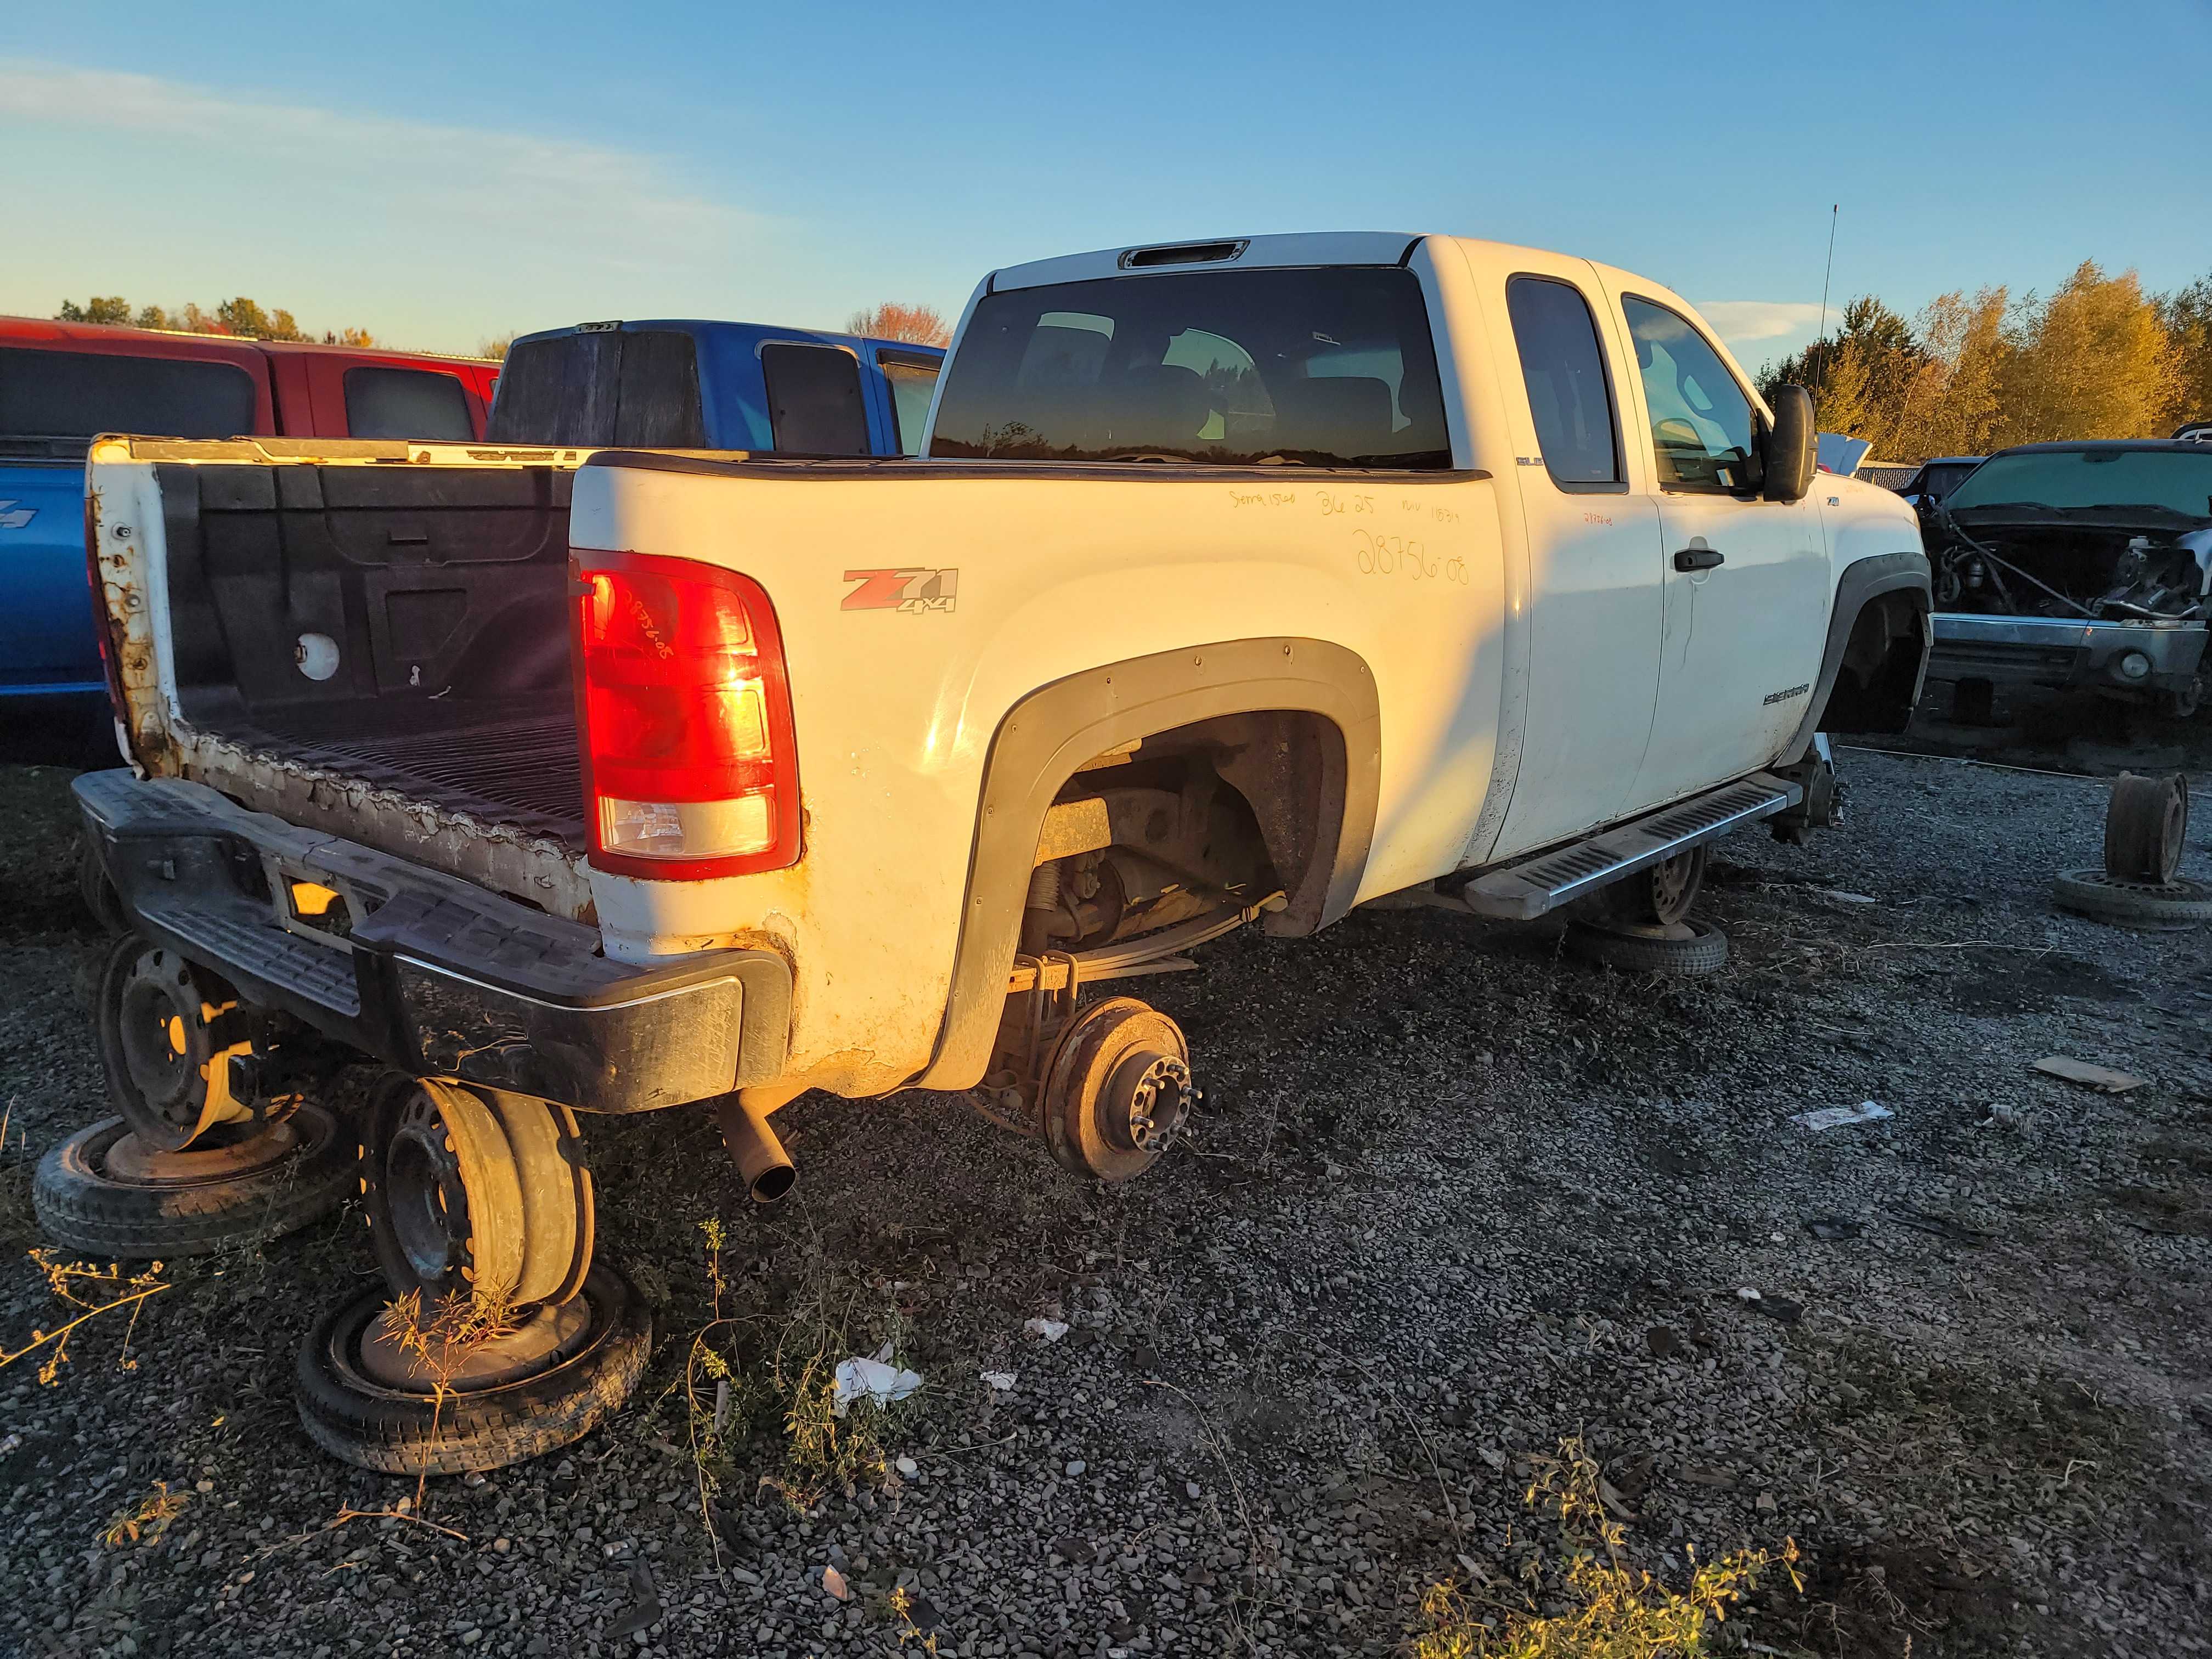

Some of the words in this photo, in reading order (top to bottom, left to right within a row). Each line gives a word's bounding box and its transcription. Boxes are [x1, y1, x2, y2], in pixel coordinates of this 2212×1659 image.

[1516, 456, 1544, 466] SLE
[1355, 495, 1374, 514] 25
[1352, 528, 1469, 585] 28756-08
[840, 567, 959, 612] Z71
